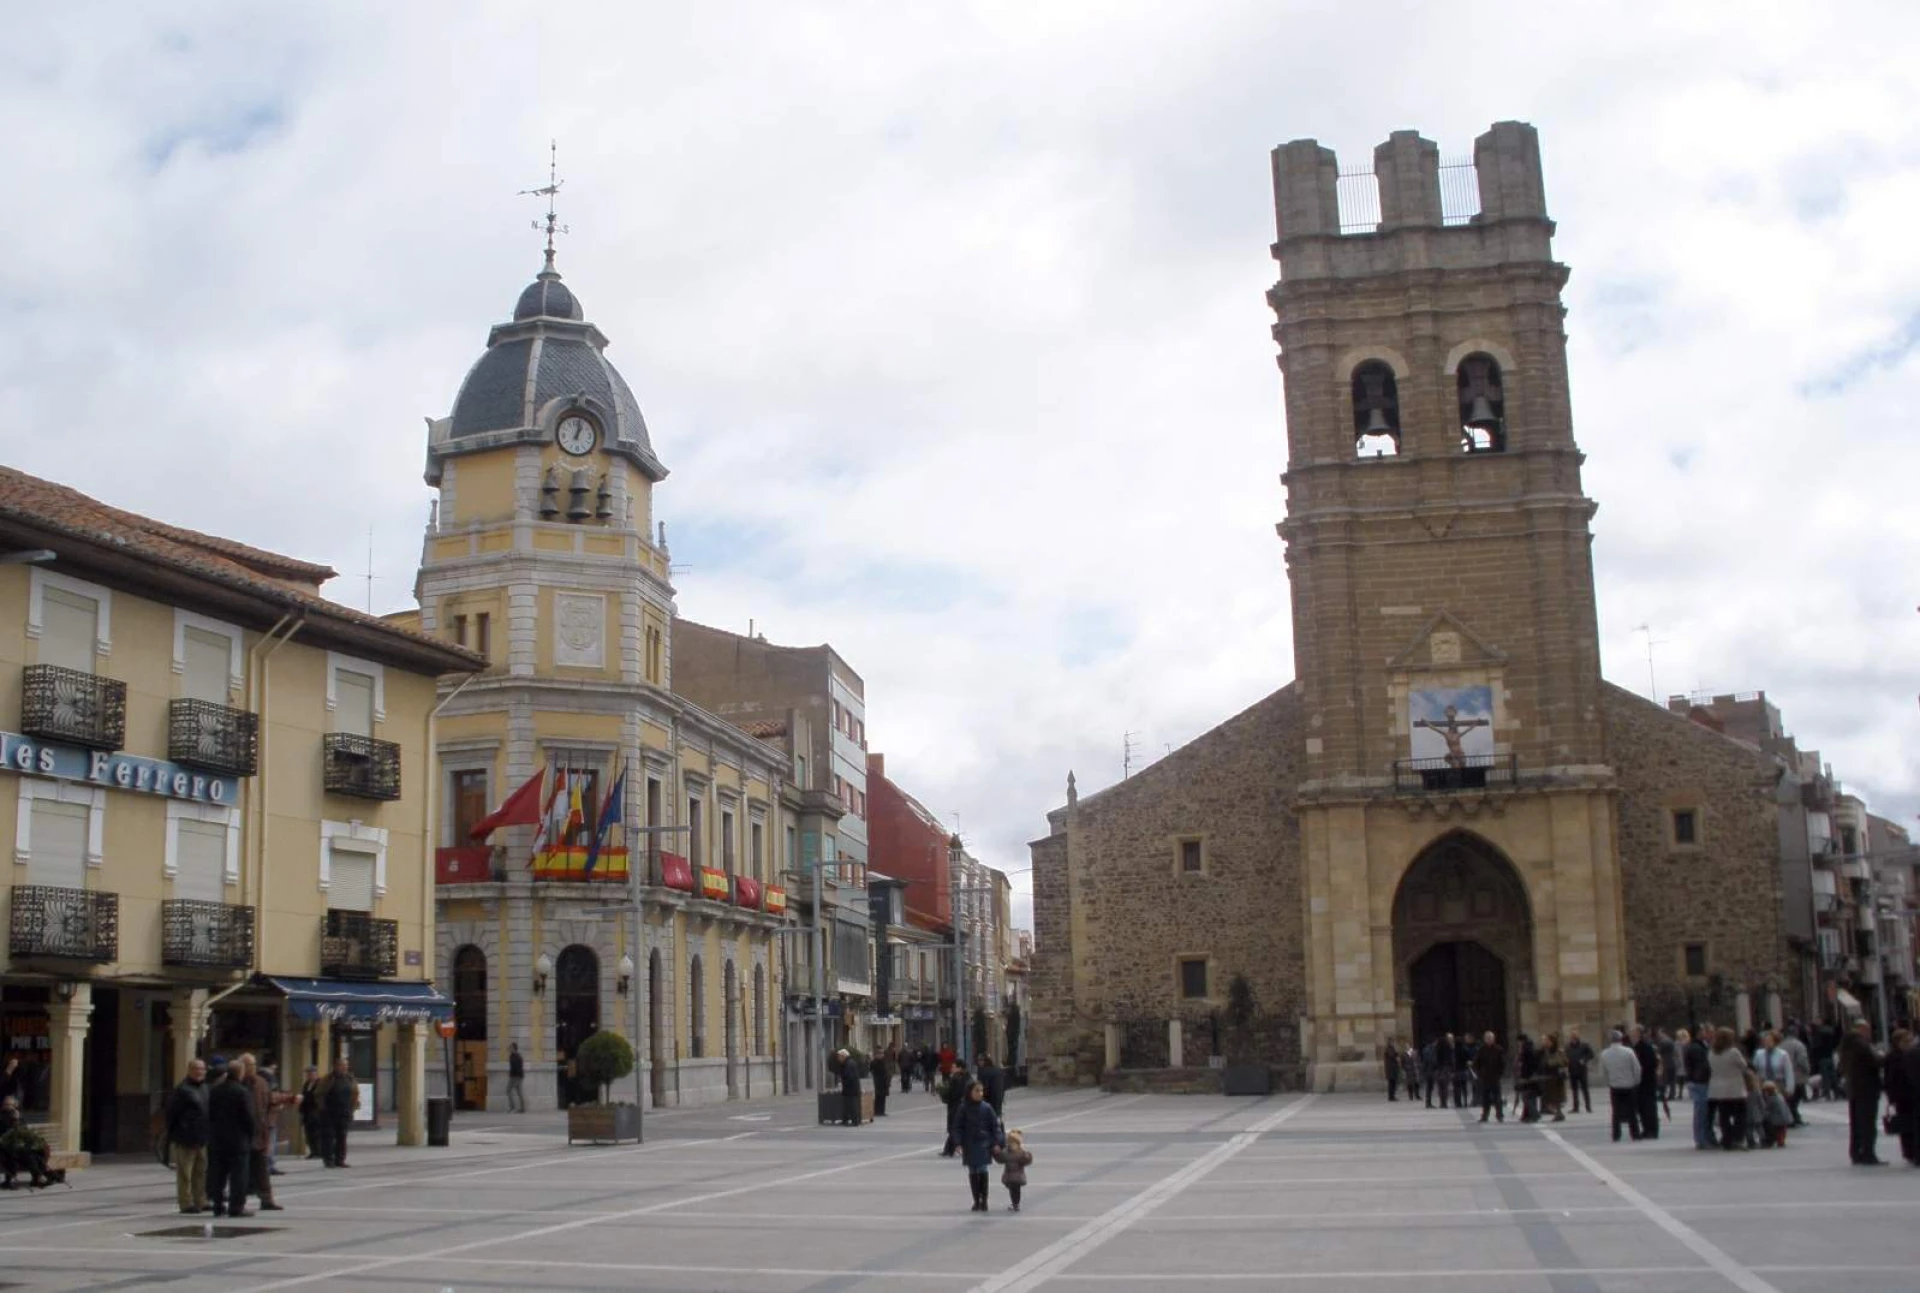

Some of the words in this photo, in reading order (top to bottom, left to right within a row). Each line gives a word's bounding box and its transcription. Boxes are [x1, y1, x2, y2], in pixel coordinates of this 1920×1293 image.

[0, 735, 55, 771] les
[89, 750, 223, 800] Ferrero
[316, 1002, 346, 1019] Café
